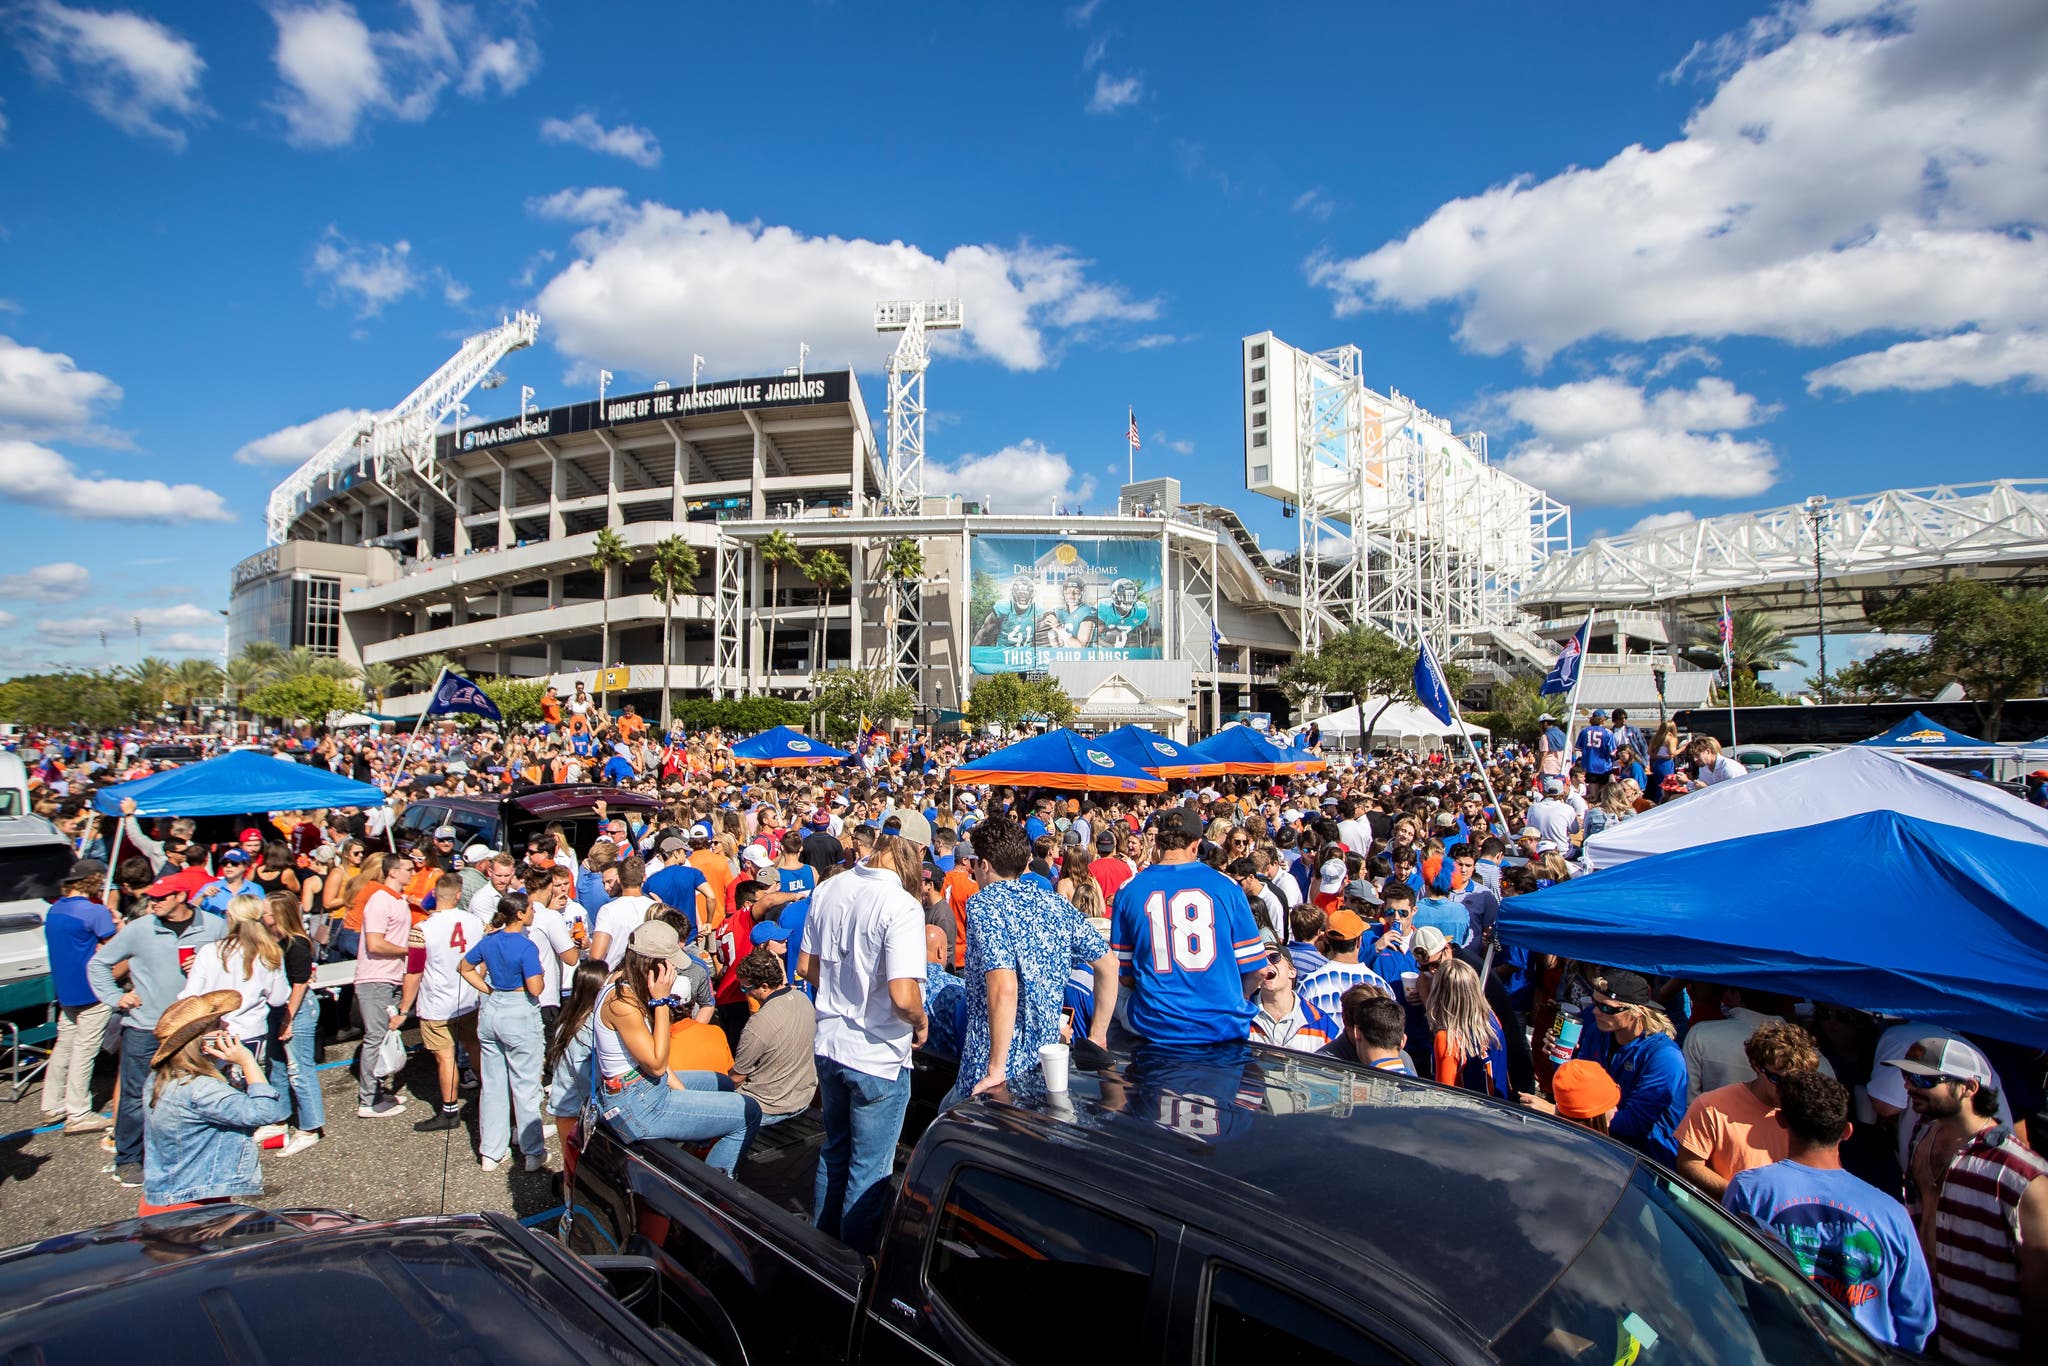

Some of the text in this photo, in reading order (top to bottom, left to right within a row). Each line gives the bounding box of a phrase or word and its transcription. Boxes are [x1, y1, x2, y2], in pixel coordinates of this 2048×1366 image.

[608, 380, 825, 421] HOME OF THE JACKSONVILLE JAGUARS
[475, 429, 498, 447] TIAA
[498, 422, 523, 441] Bank
[1013, 564, 1047, 574] DREAM
[1087, 565, 1118, 575] HOMES
[1007, 624, 1033, 648] 41
[1003, 650, 1032, 665] THIS
[1037, 650, 1050, 665] IS
[1586, 730, 1603, 748] 15
[450, 922, 467, 954] 4
[1144, 888, 1217, 973] 18
